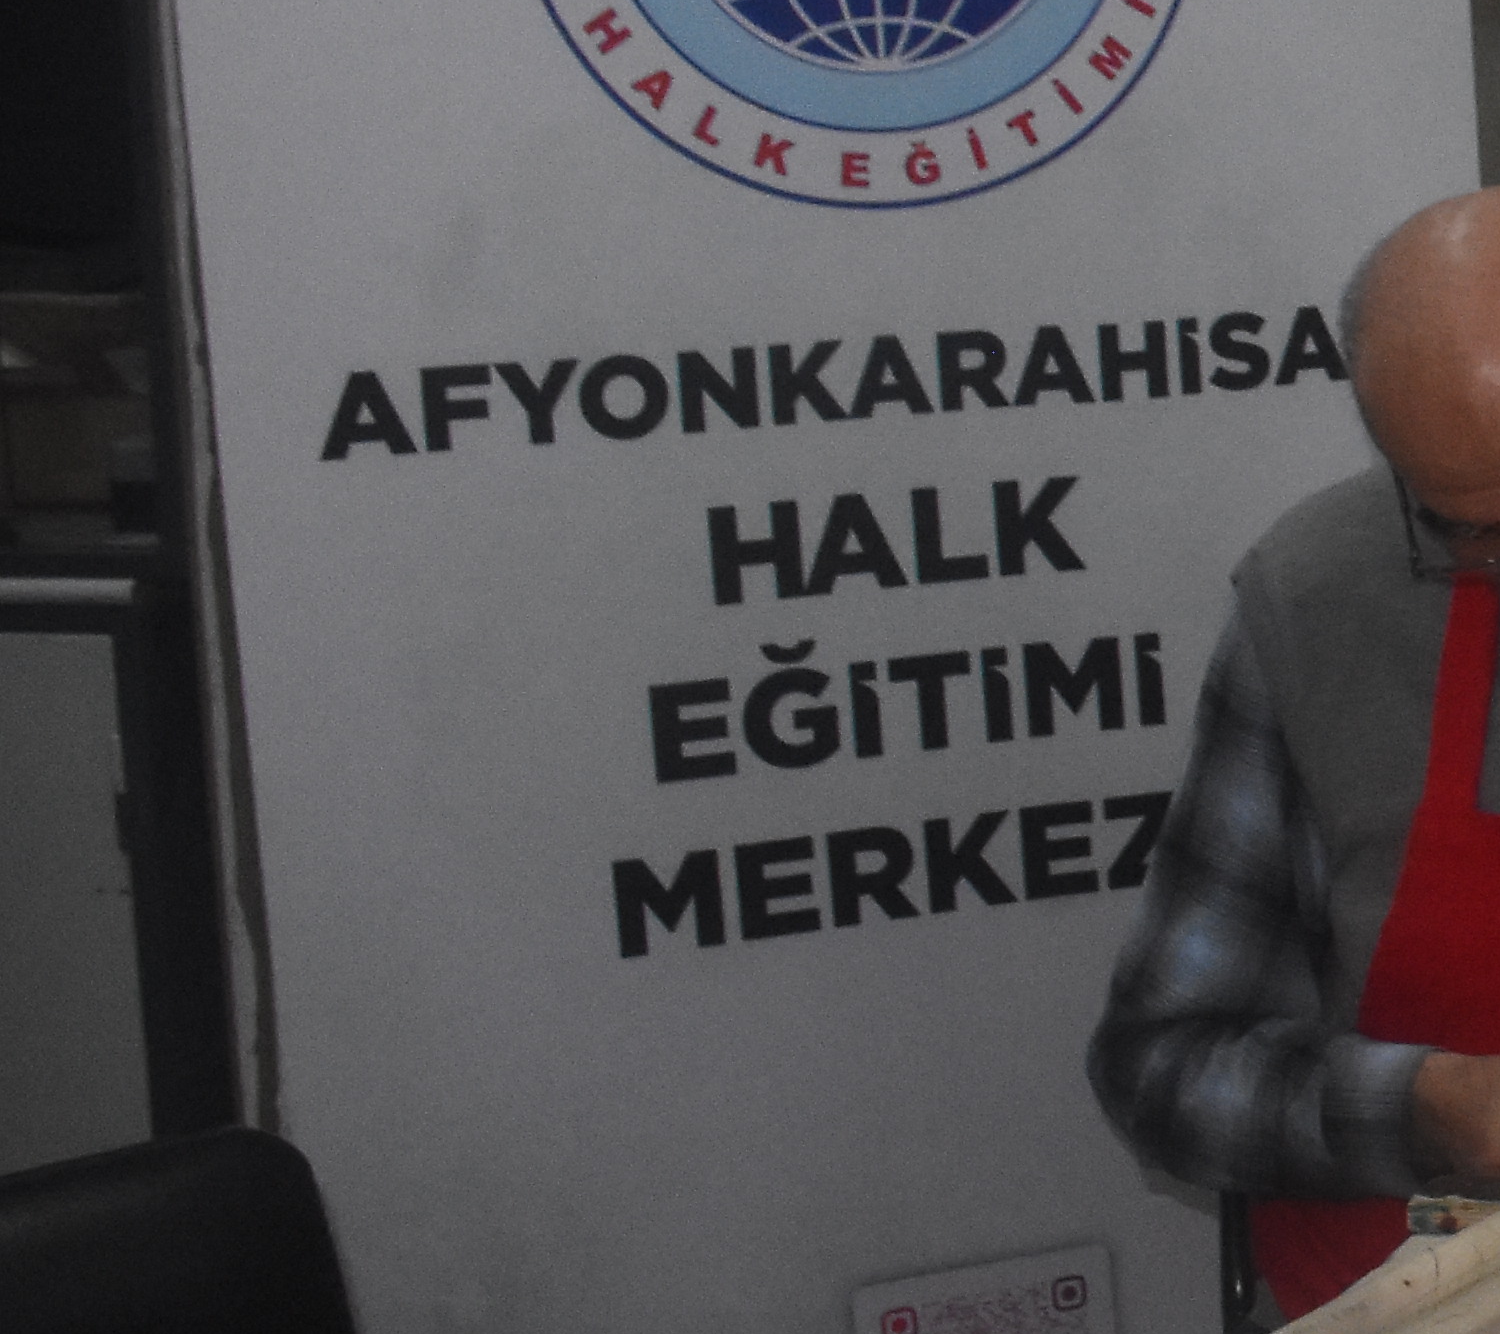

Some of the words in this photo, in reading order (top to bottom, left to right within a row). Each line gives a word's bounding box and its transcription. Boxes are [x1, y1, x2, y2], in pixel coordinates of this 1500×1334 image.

[583, 7, 796, 178] HALK
[320, 304, 1352, 461] AFYONKARAHİSA
[706, 476, 1087, 607] HALK
[647, 632, 1168, 784] EĞİTİMİ
[611, 790, 1173, 958] MERKEZ
